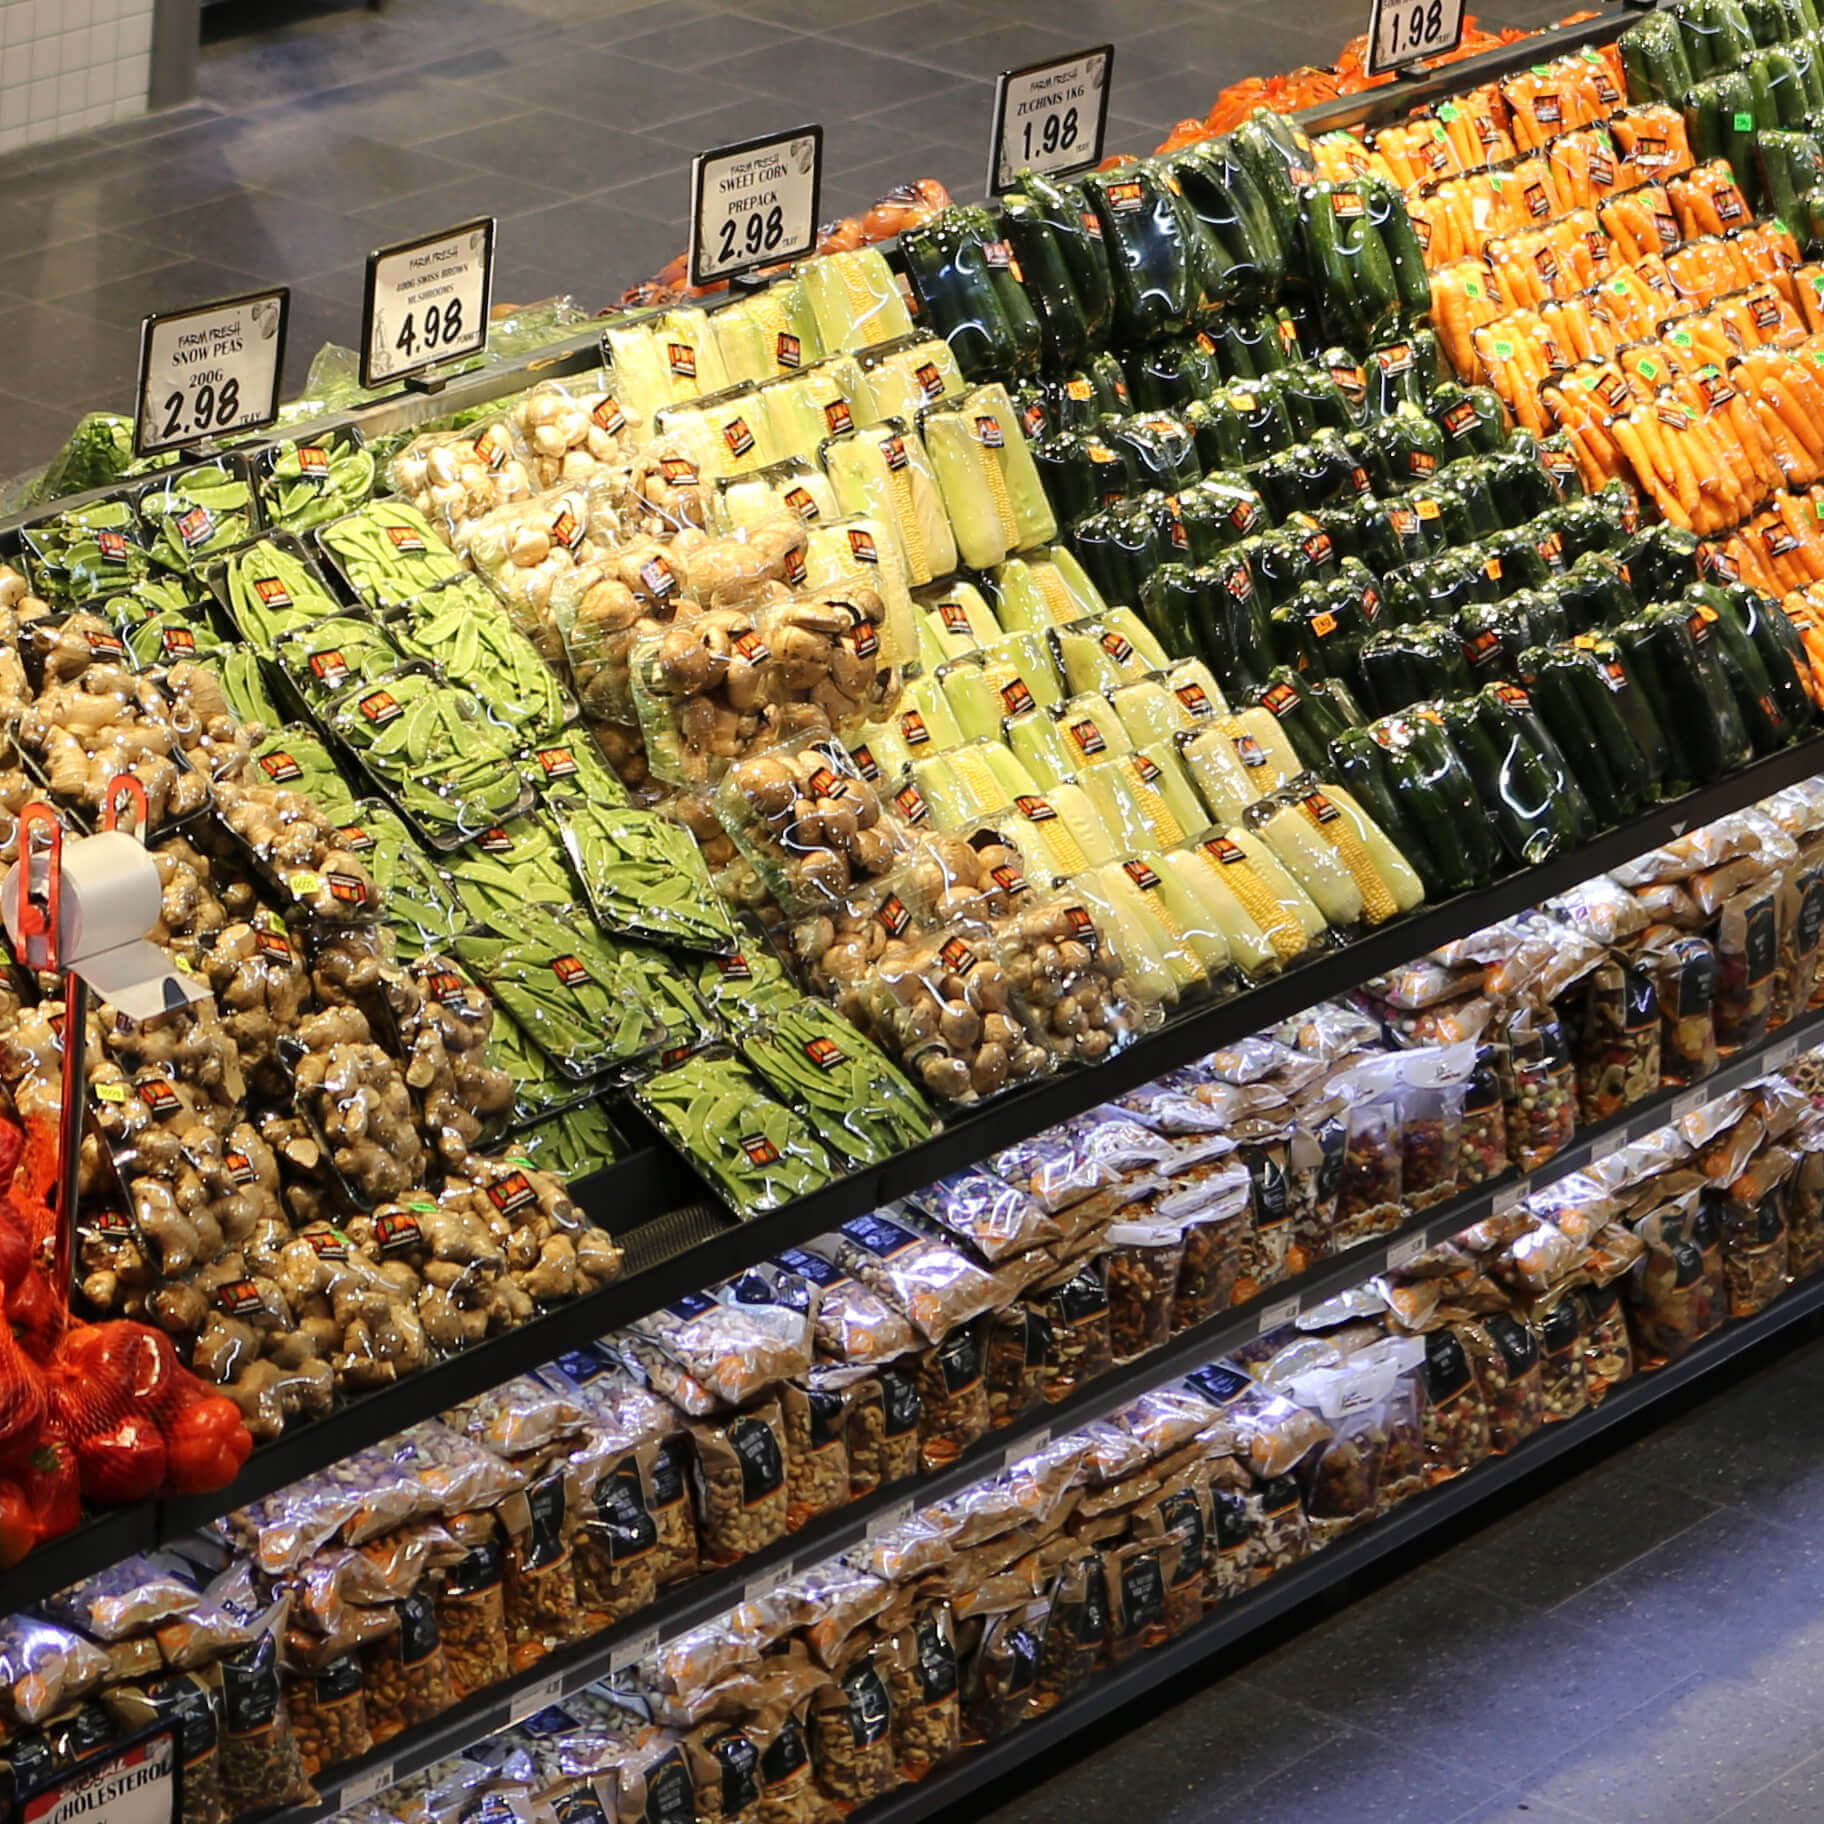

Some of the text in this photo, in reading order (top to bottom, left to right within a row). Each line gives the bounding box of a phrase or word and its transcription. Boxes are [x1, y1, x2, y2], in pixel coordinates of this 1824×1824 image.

[1016, 84, 1086, 117] ZUCHINIS 1KG
[1023, 107, 1078, 161] 1.98
[719, 163, 789, 194] SWEET CORN
[728, 190, 778, 215] PREPACK
[718, 205, 784, 264] 2.98
[178, 322, 241, 349] FARM FRESH
[396, 297, 463, 357] 4.98
[171, 337, 244, 368] SNOW PEAS
[189, 367, 224, 389] 200G
[162, 378, 240, 439] 2.98
